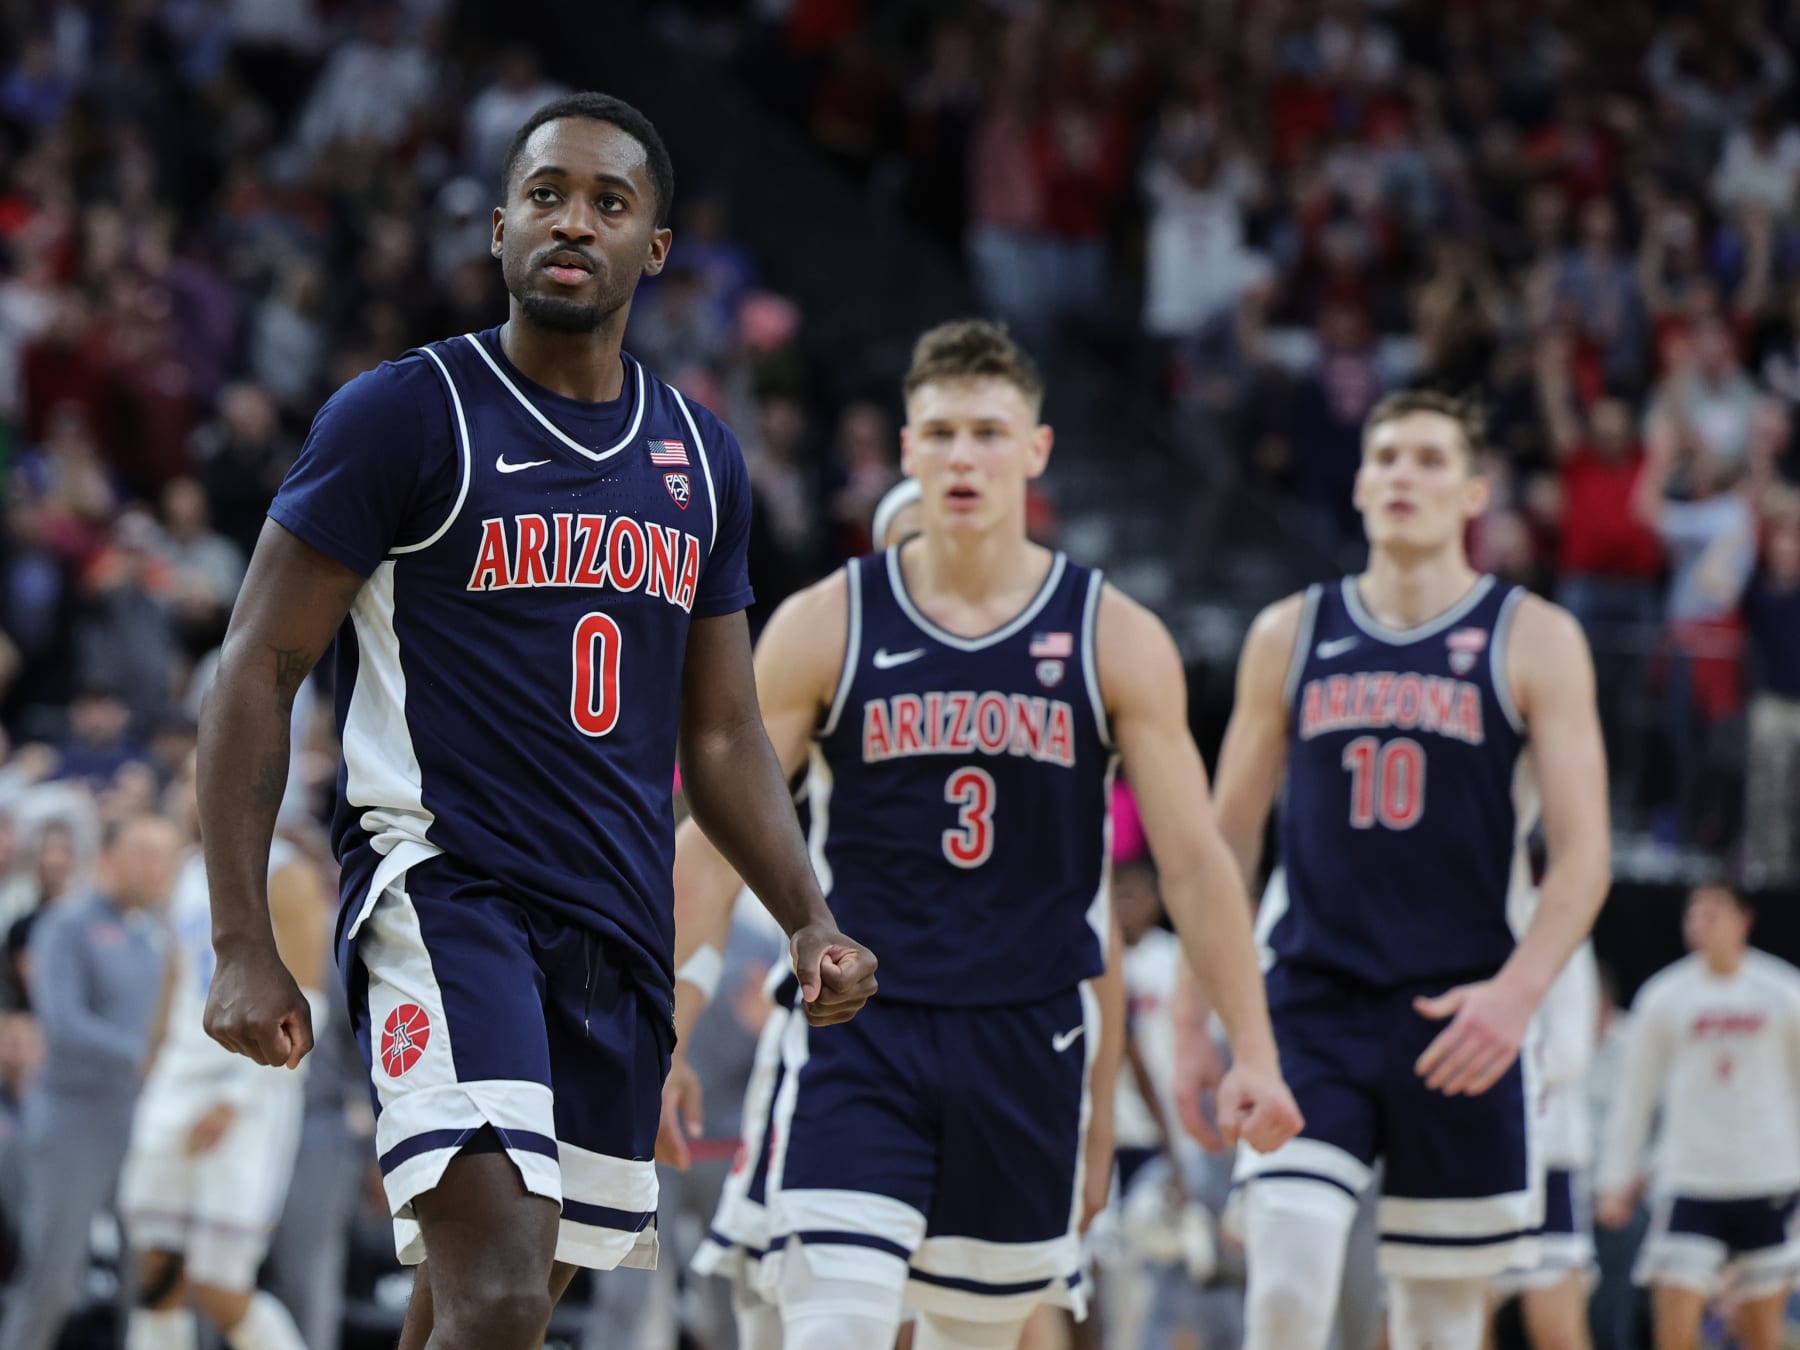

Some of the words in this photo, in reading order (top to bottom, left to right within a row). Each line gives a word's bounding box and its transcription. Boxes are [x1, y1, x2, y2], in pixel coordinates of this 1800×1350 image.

[665, 474, 689, 494] PAC
[673, 488, 687, 501] 12
[466, 512, 700, 615] ARIZONA
[570, 611, 622, 738] 0
[1300, 671, 1486, 746] ARIZONA
[862, 690, 1076, 768] ARIZONA
[942, 766, 996, 869] 3
[1342, 736, 1427, 831] 10
